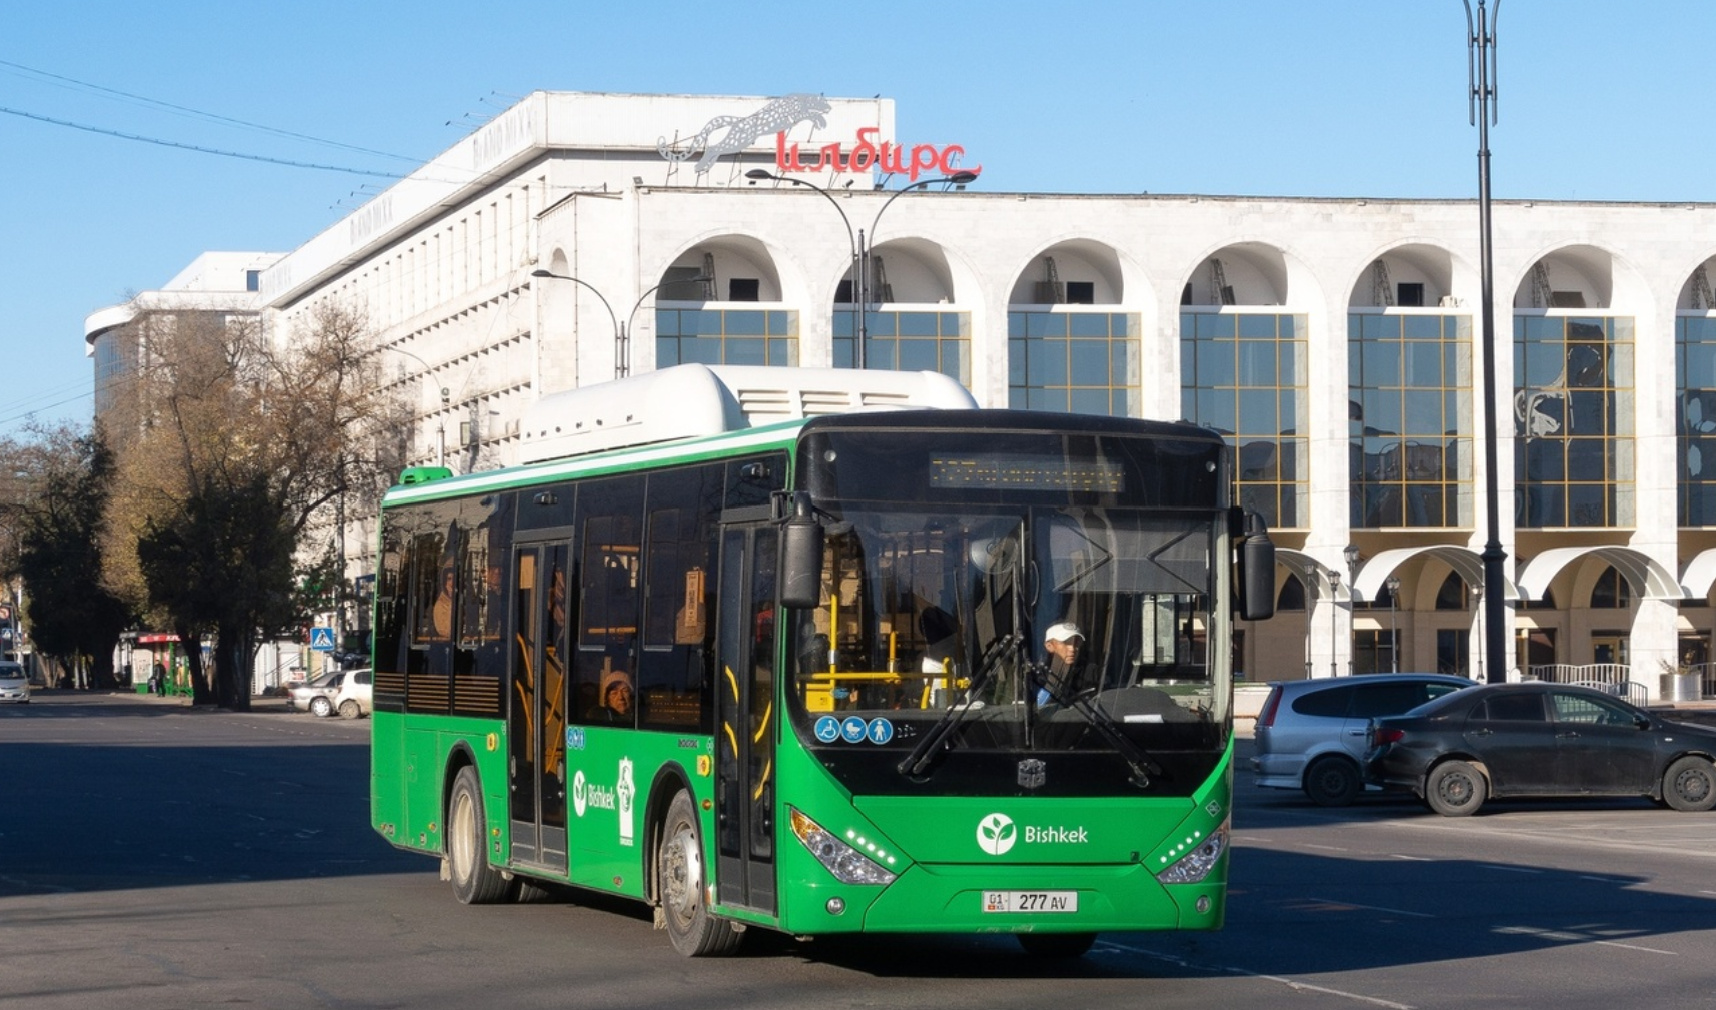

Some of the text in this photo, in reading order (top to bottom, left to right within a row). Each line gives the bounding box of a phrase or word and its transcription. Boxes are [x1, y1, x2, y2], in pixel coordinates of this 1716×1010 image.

[588, 784, 615, 810] Bishkek
[1025, 826, 1088, 844] Bishkek
[989, 894, 1067, 910] 01 277 AV
